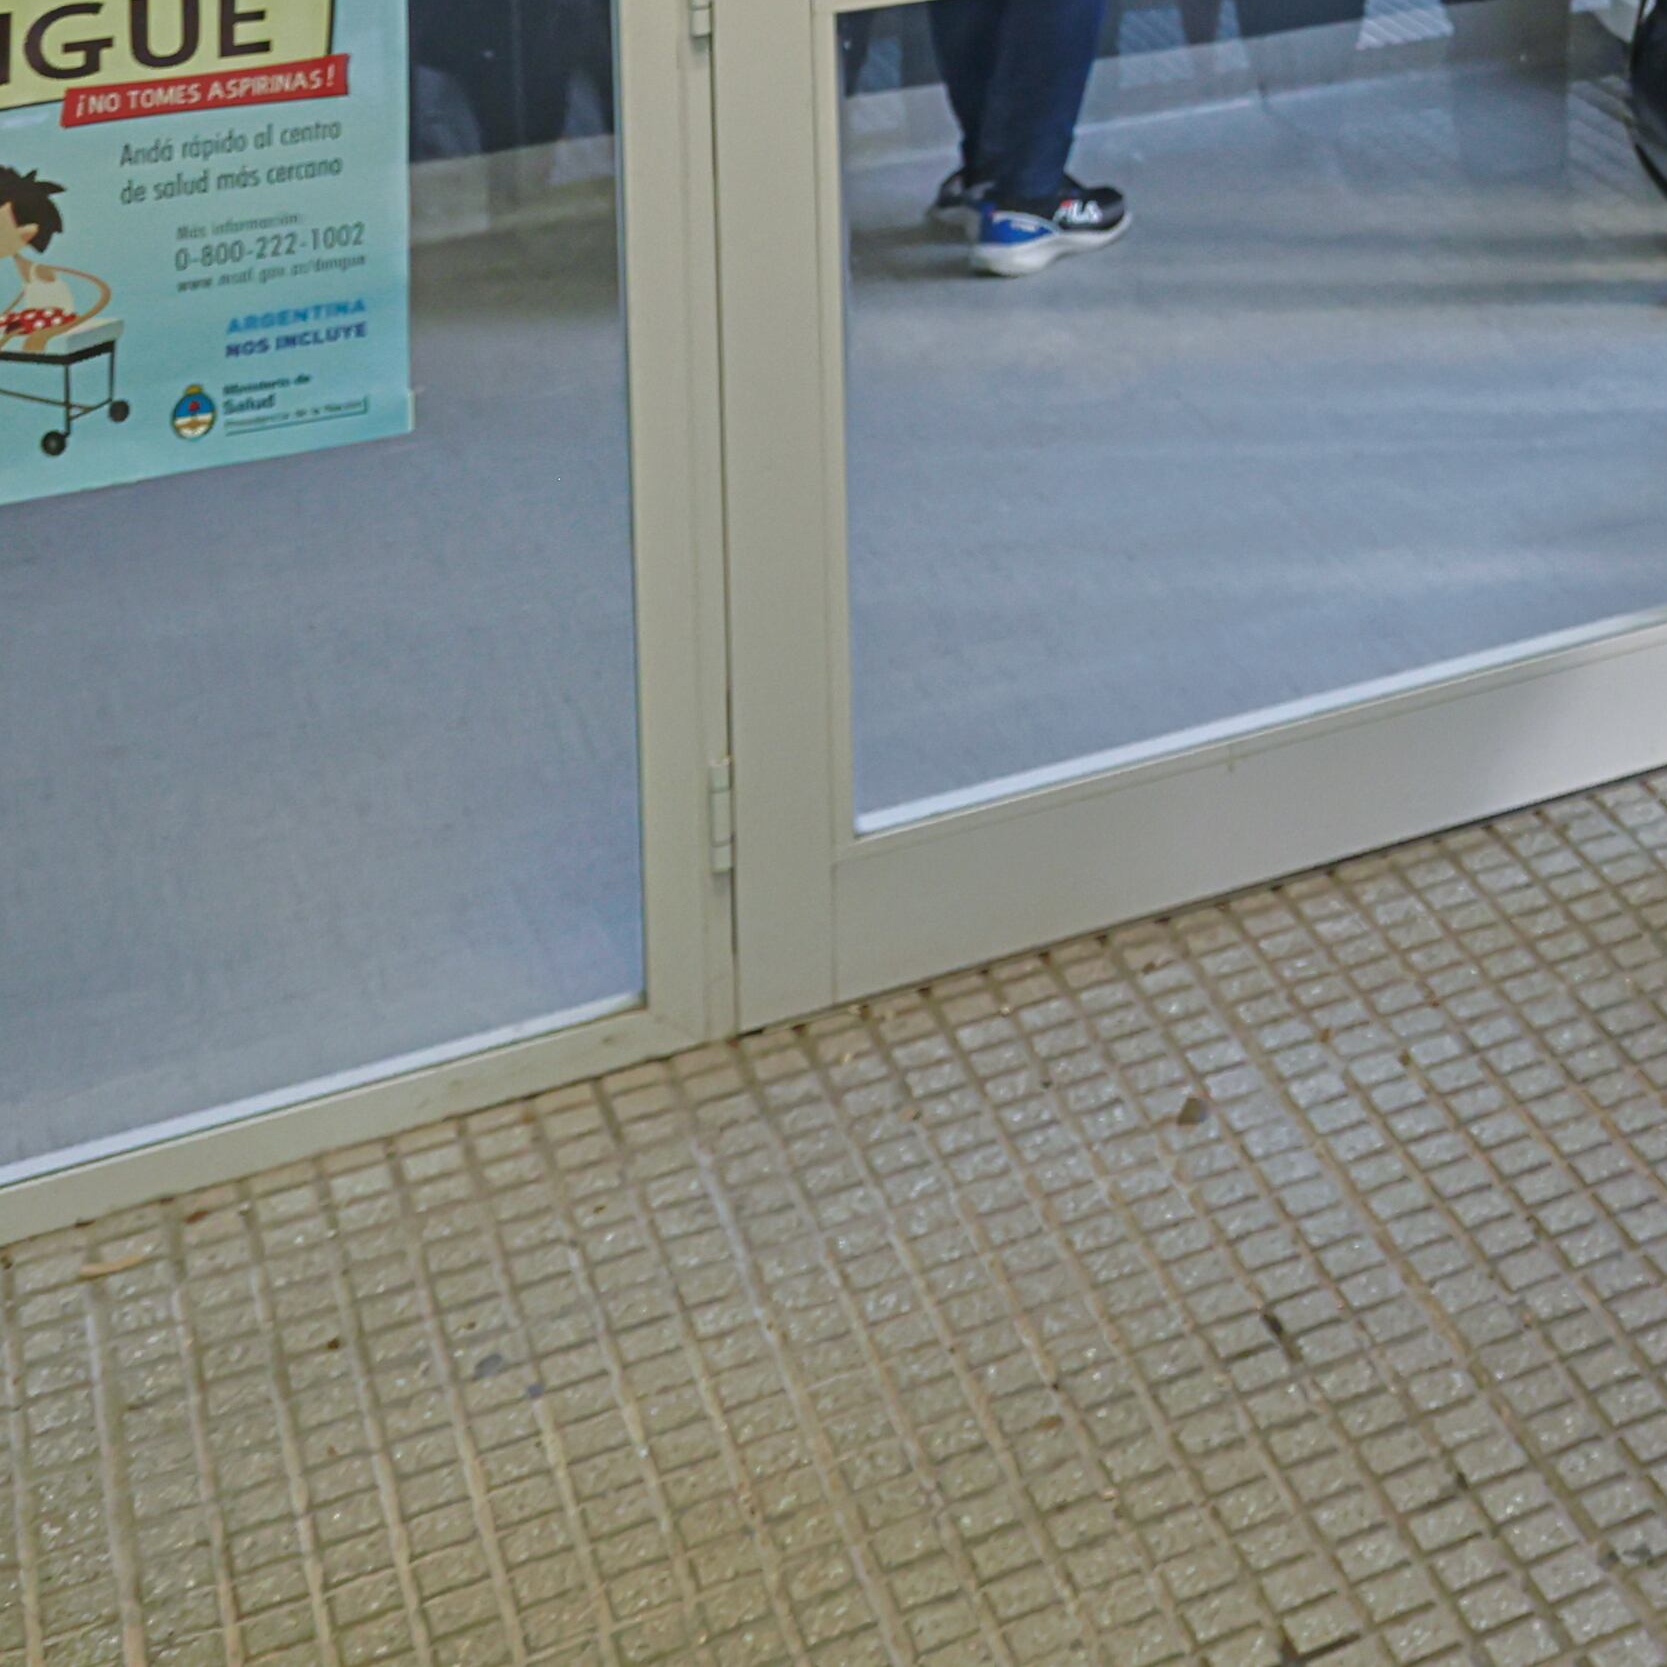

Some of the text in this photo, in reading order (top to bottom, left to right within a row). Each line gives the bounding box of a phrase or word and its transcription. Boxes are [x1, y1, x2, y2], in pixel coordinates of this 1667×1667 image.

[75, 91, 121, 118] ¡NO
[126, 84, 201, 110] TOMES
[119, 120, 343, 167] Andá rápido al centro
[119, 157, 344, 205] de salud más cercano
[174, 220, 366, 272] 0-800-222-1002
[227, 298, 366, 334] ARGENTINA
[225, 320, 367, 358] NOS INCLUYE
